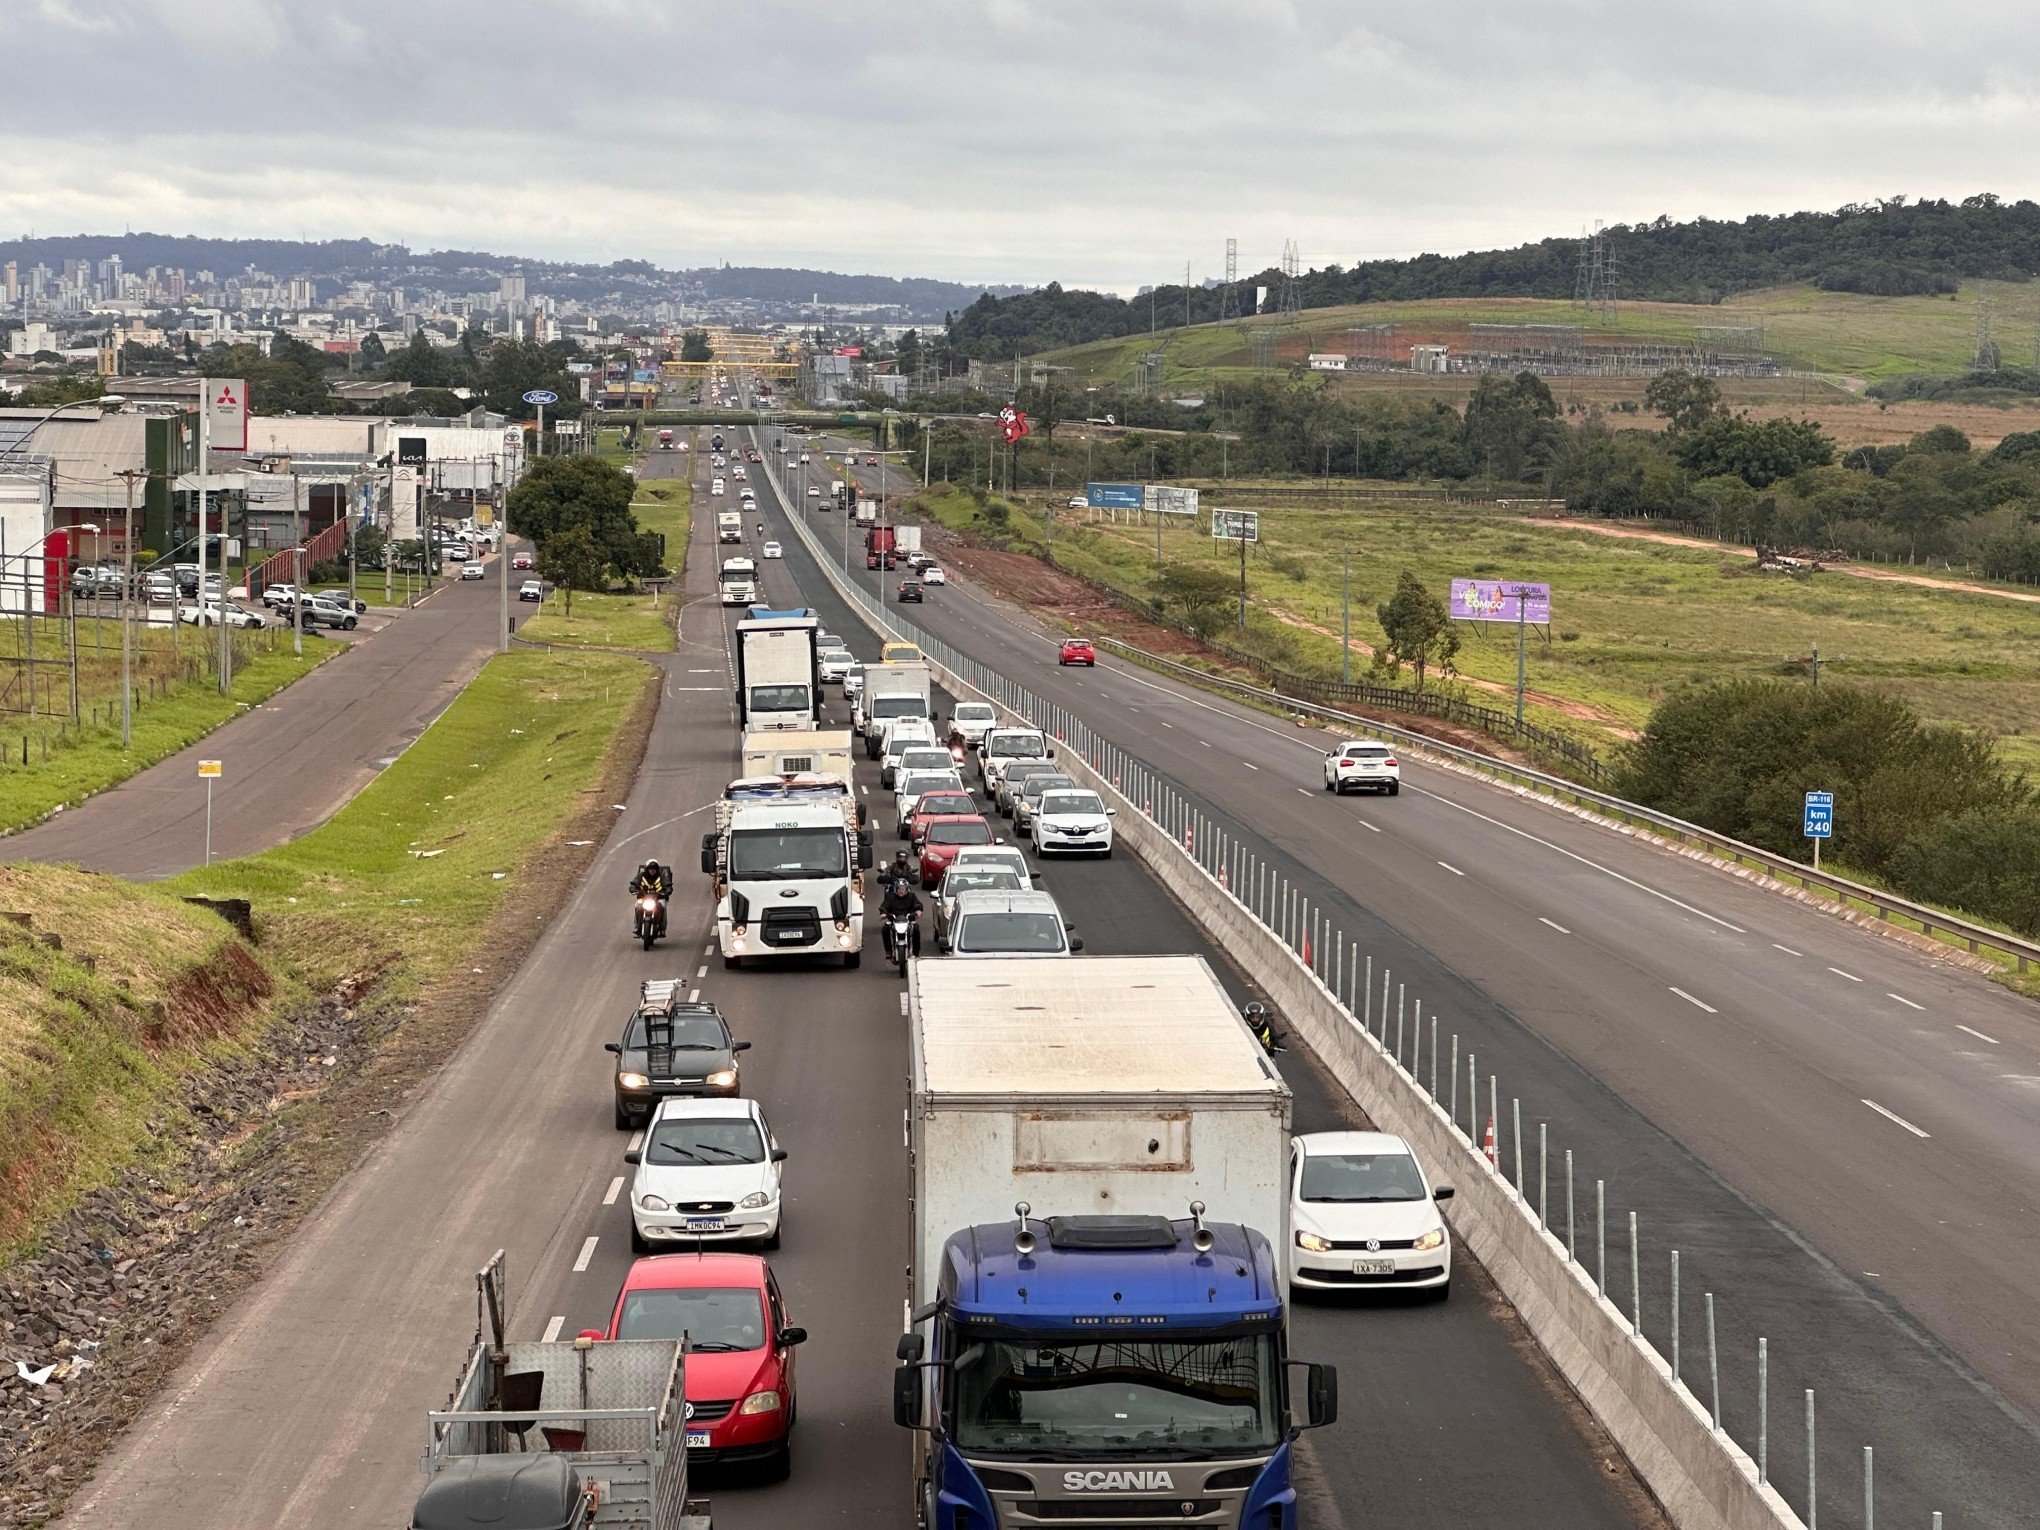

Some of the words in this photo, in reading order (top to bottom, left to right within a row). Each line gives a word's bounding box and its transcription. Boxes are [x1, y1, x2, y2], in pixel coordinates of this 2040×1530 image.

[529, 392, 551, 402] Ford
[1466, 600, 1505, 609] COMIGO!
[1811, 810, 1826, 819] km
[1807, 822, 1829, 832] 240
[1063, 1471, 1175, 1490] SCANIA
